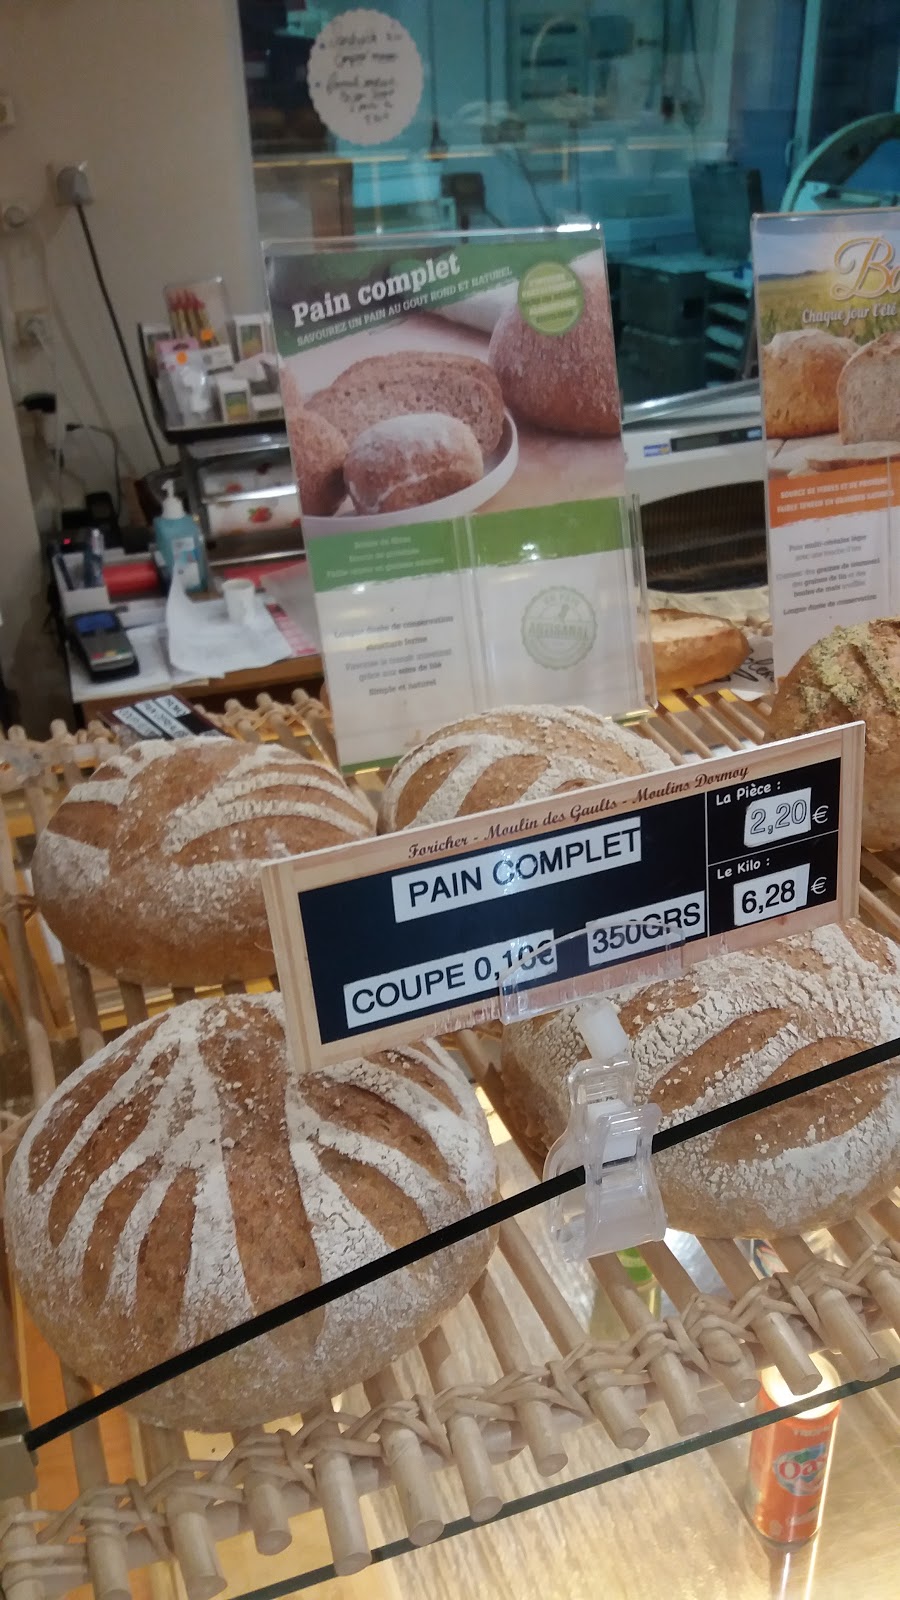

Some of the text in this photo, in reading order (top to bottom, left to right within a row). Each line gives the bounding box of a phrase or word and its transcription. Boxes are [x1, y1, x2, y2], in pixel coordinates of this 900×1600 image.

[292, 253, 460, 328] Pain complet
[297, 321, 347, 346] SAVOUREZ
[348, 316, 362, 330] UN
[364, 308, 386, 324] PAIN
[388, 302, 401, 316] AU
[431, 285, 456, 301] ROND
[458, 280, 469, 292] ET
[471, 266, 513, 287] NATUREL
[802, 308, 844, 327] Chaque
[843, 304, 869, 326] jour
[408, 835, 468, 858] Foricher
[483, 818, 538, 841] Moulin
[543, 811, 566, 826] des
[570, 798, 617, 823] Gaults
[632, 781, 690, 804] Moulins
[694, 767, 749, 788] Dormoy
[716, 793, 731, 806] La
[736, 783, 772, 800] Pièce
[749, 799, 829, 835] 2,20 €
[408, 827, 641, 908] PAIN COMPLET
[717, 867, 732, 880] Le
[737, 859, 761, 875] Kilo
[741, 876, 827, 914] 6,28 €
[352, 902, 701, 1014] COUPE 0,10€ 350GRS
